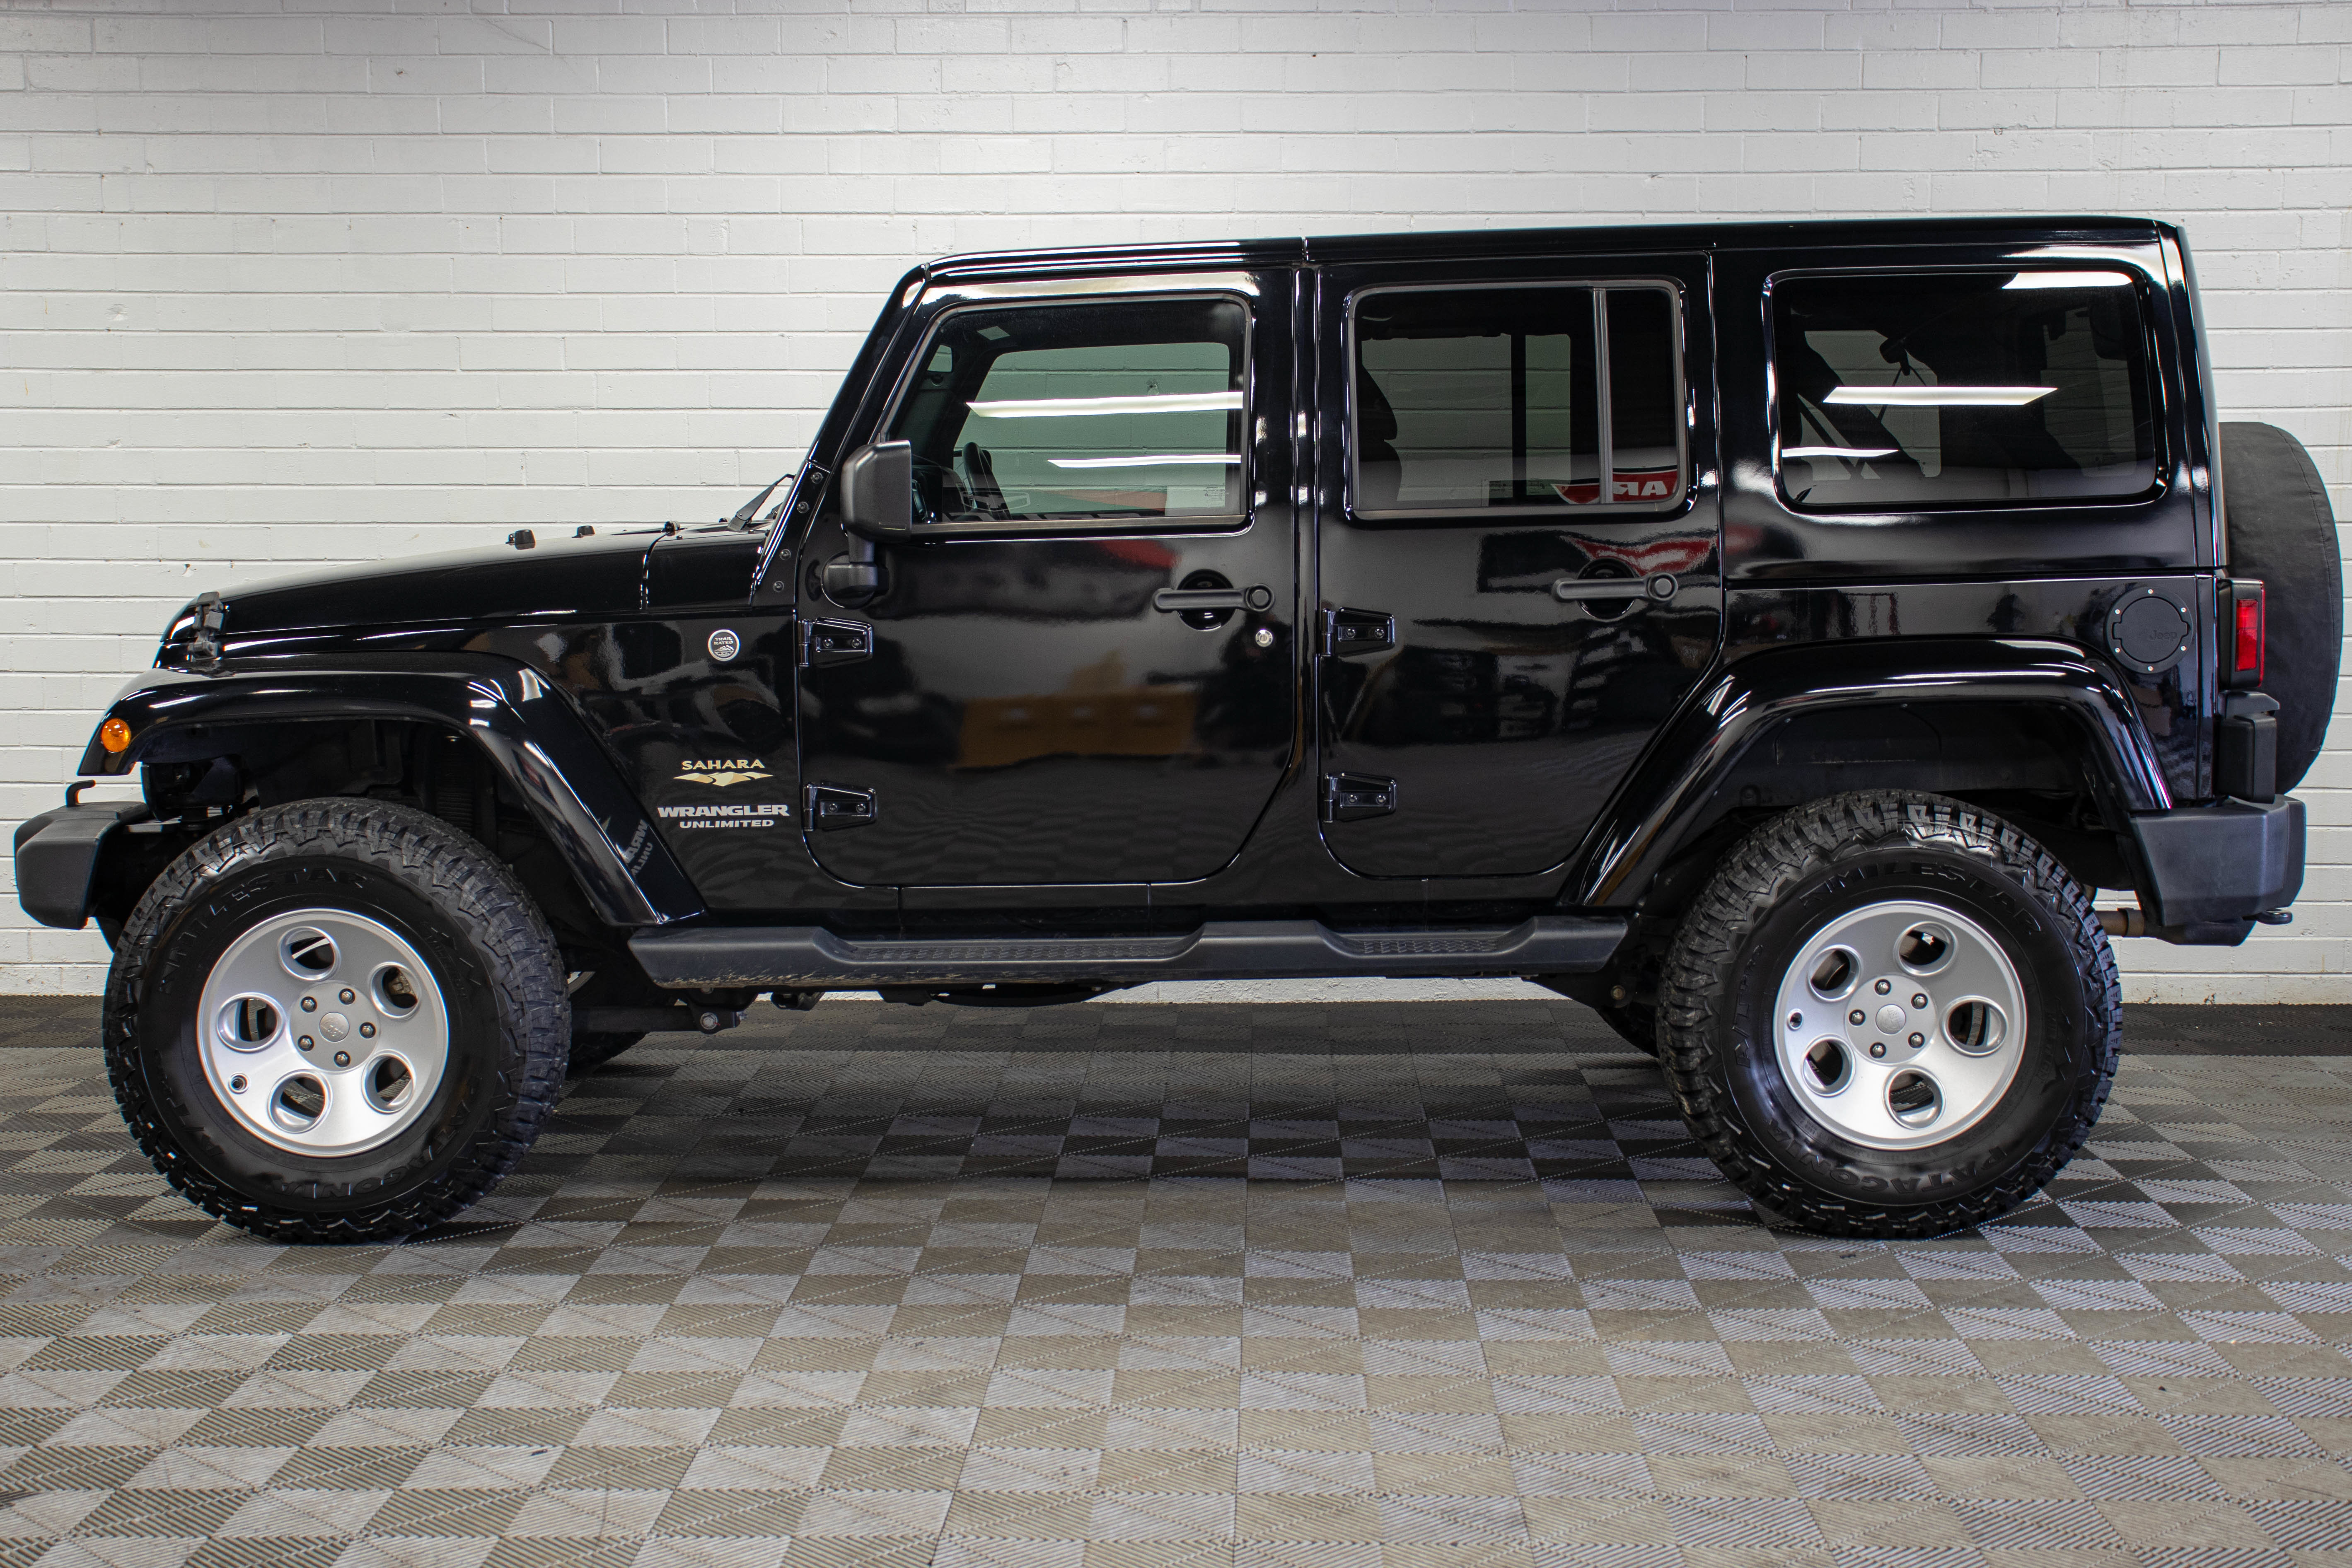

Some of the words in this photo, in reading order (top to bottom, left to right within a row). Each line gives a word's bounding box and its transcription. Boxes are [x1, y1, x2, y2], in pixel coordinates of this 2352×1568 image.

[2148, 630, 2178, 642] Jeep
[682, 759, 765, 770] SAHARA
[657, 804, 790, 817] WRANGLER
[679, 819, 774, 829] UNLIMITED
[1827, 860, 2042, 938] MILESTAR
[1762, 1118, 2007, 1196] PATAGONIA
